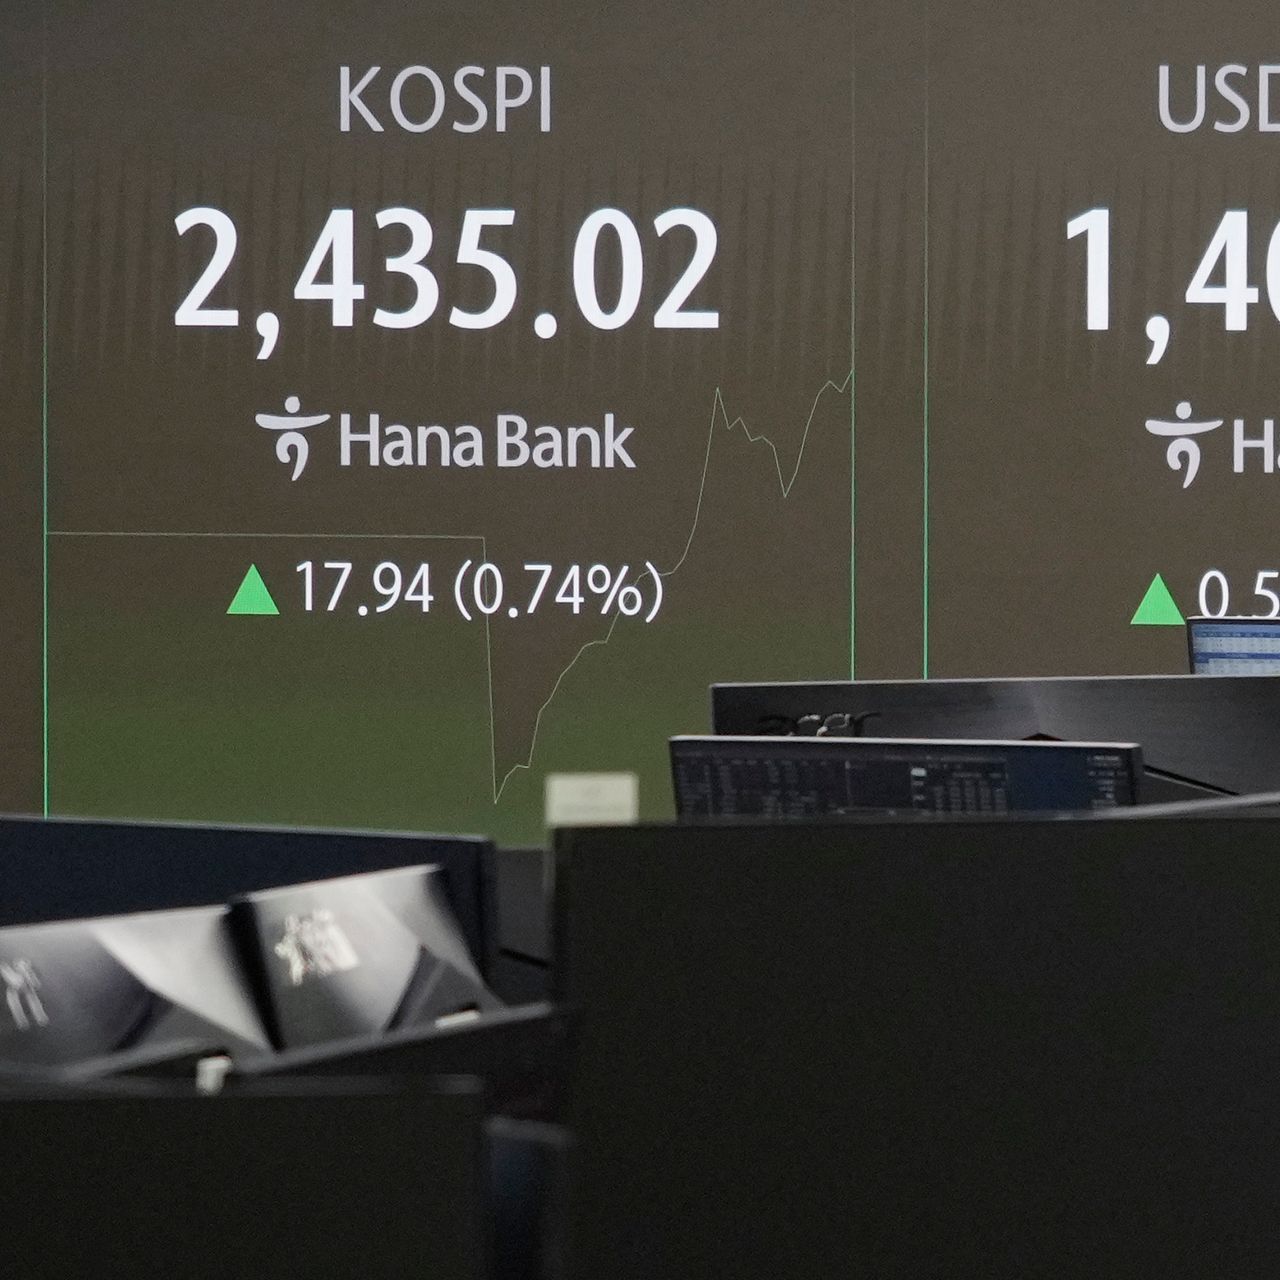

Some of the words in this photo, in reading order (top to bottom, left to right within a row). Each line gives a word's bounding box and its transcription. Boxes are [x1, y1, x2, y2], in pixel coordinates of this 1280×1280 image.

[339, 65, 551, 133] KOSPI
[174, 206, 720, 360] 2,435.02
[340, 413, 484, 468] Hana
[496, 413, 637, 469] Bank
[296, 561, 435, 618] 17.94
[454, 561, 664, 624] (0.74%)
